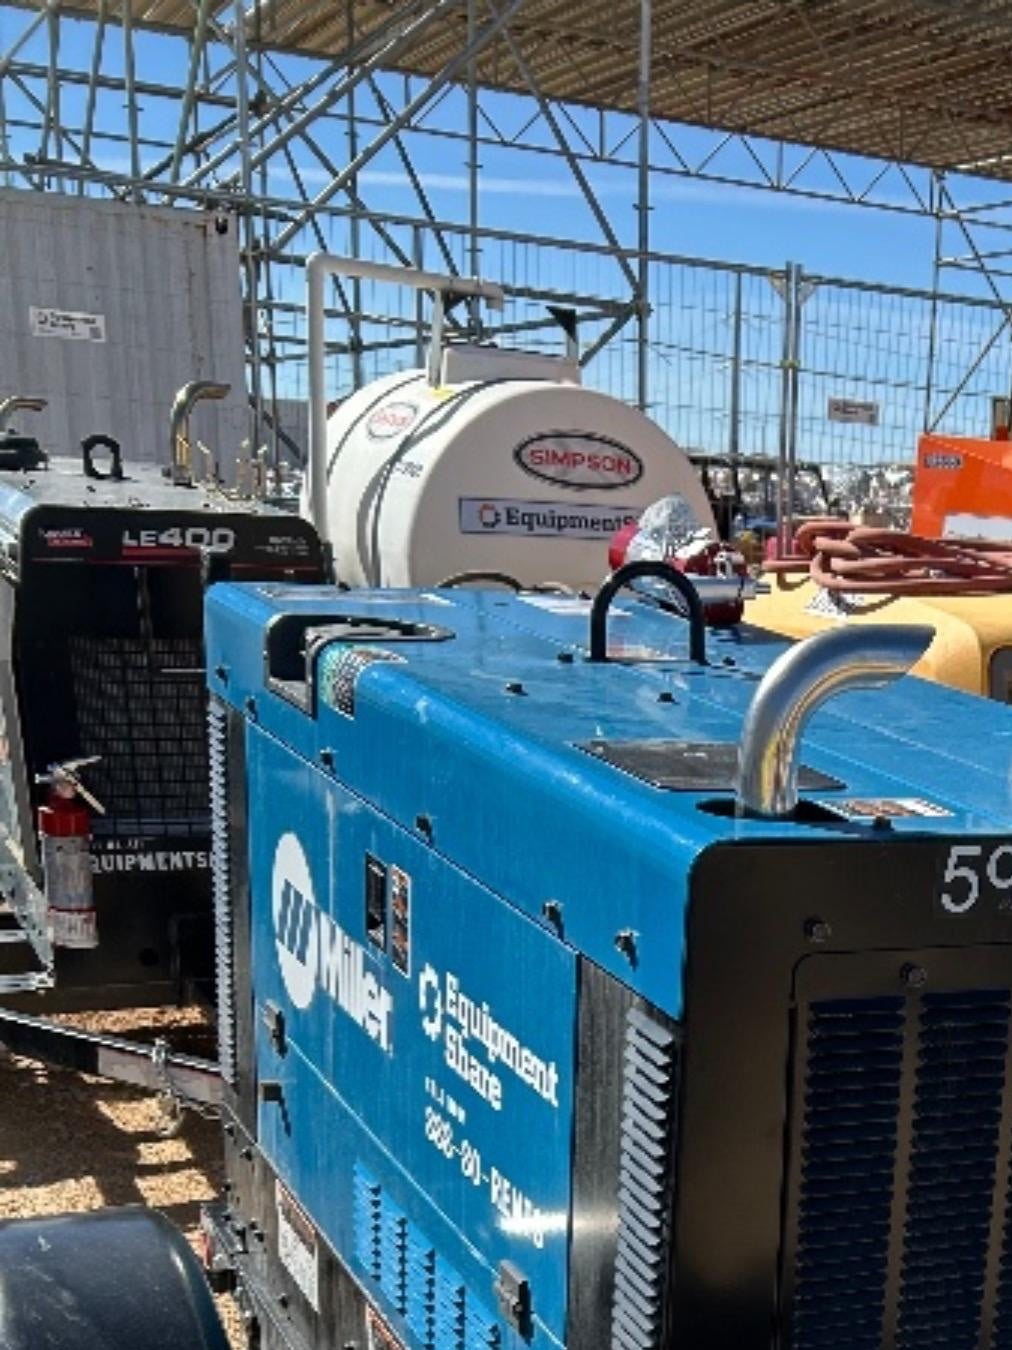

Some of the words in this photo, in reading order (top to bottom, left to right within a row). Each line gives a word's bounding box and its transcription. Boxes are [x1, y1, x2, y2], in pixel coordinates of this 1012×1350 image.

[528, 449, 633, 475] SIMPSON
[122, 527, 235, 553] LE400
[318, 905, 393, 1052] Miller
[445, 970, 559, 1108] Equipment
[445, 1024, 502, 1112] Share
